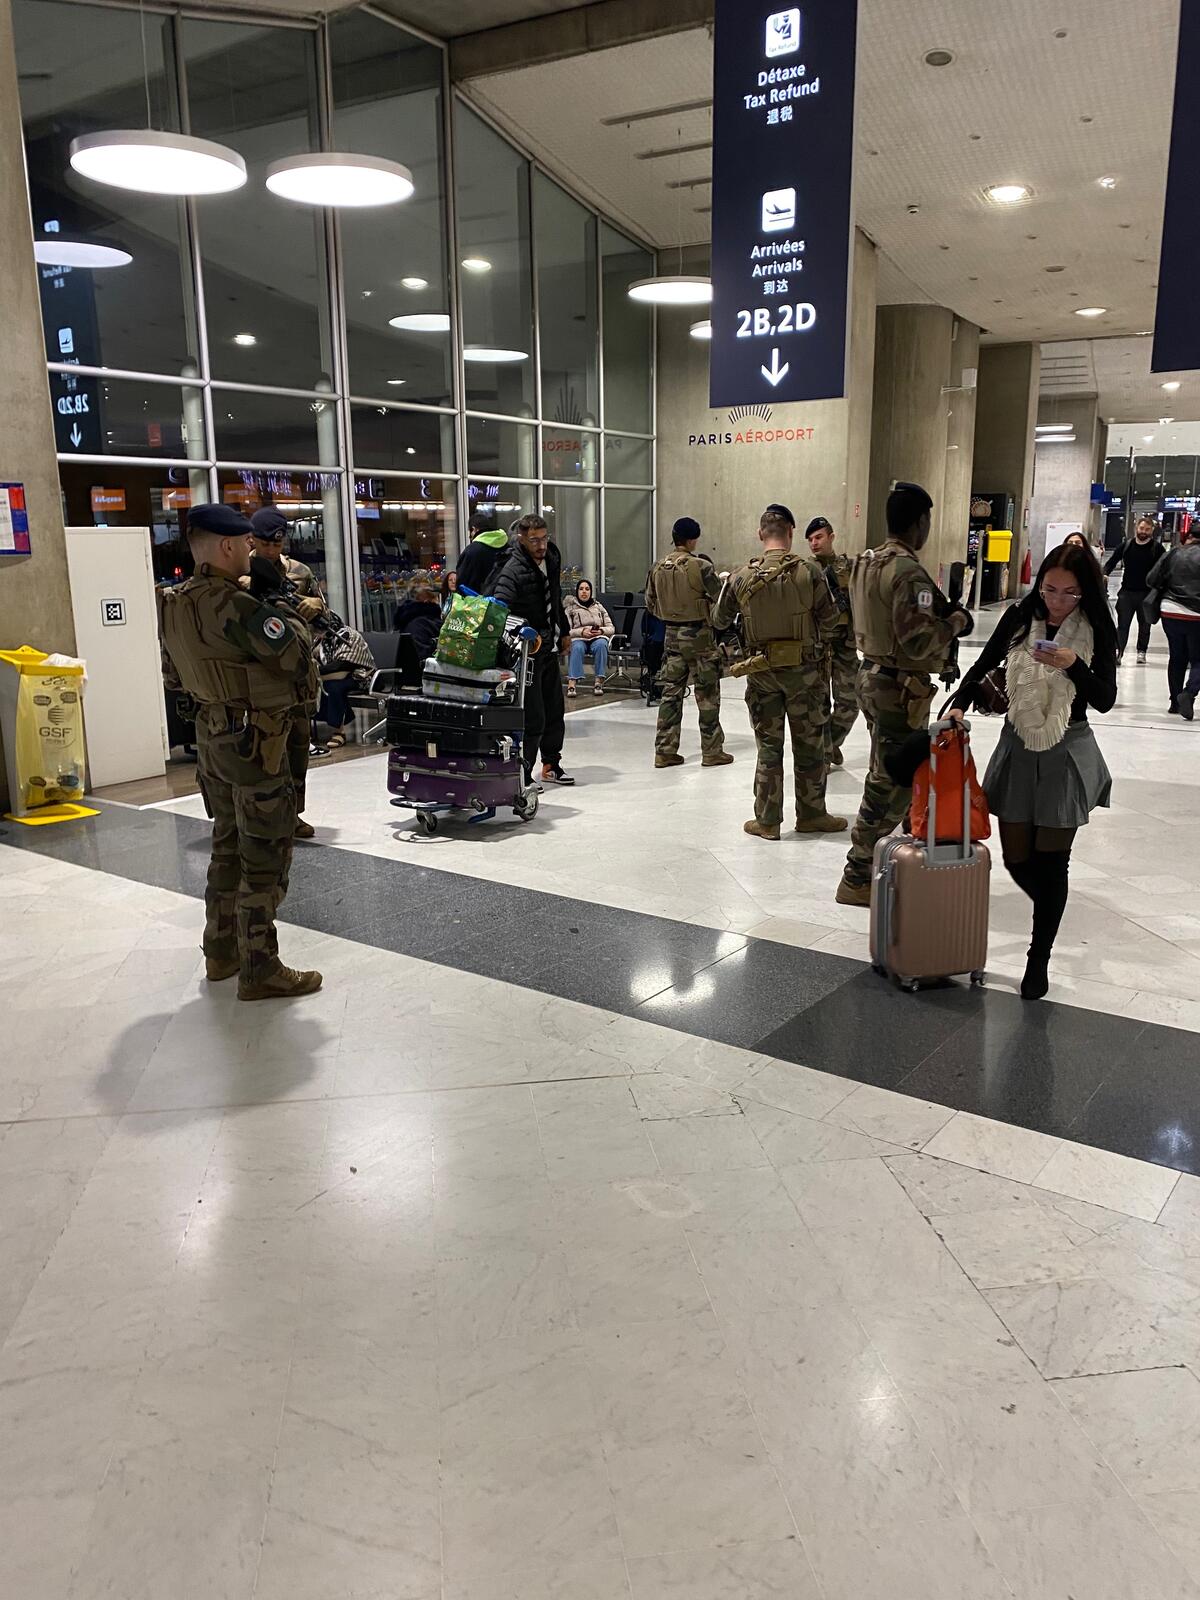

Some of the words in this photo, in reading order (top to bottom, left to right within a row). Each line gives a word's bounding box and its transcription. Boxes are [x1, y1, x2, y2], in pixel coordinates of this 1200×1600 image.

[758, 64, 805, 87] Détaxe
[743, 94, 766, 109] Tax
[769, 77, 819, 103] Refund
[766, 105, 793, 125] 退税
[750, 240, 805, 259] Arrivées
[752, 257, 803, 277] Arrivals
[763, 279, 788, 294] 到达
[736, 302, 816, 338] 2B,2D
[688, 433, 732, 446] PARIS
[734, 428, 815, 444] AÉROPORT
[39, 726, 73, 738] GSF
